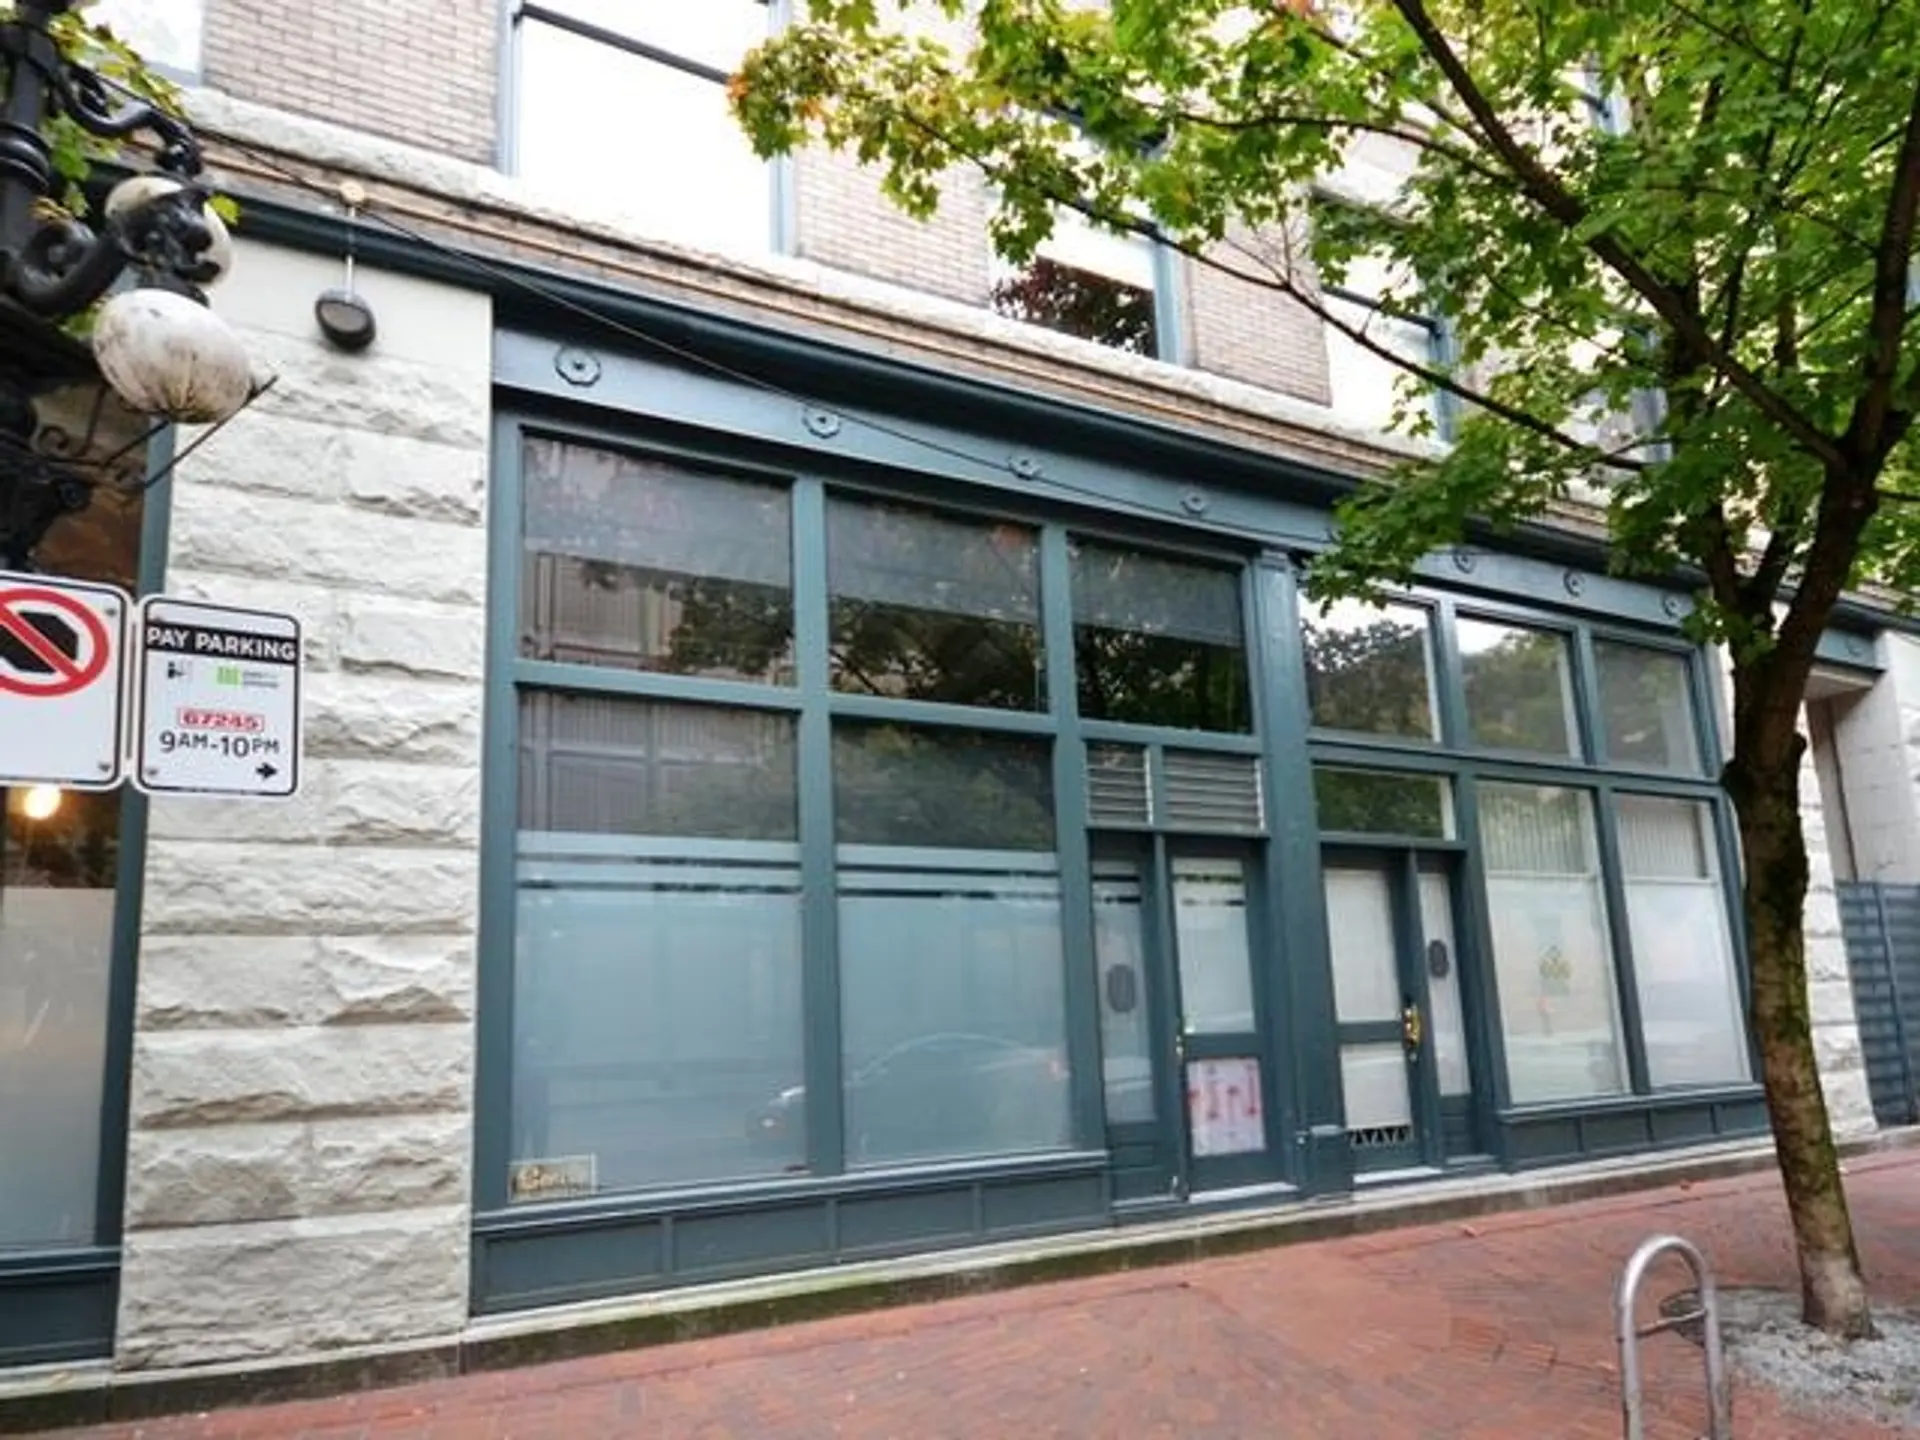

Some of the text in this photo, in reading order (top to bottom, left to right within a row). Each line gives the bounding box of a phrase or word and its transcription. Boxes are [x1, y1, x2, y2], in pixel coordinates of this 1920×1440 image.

[146, 626, 296, 660] PAY PARKING
[159, 731, 280, 758] 9AM-10PM
